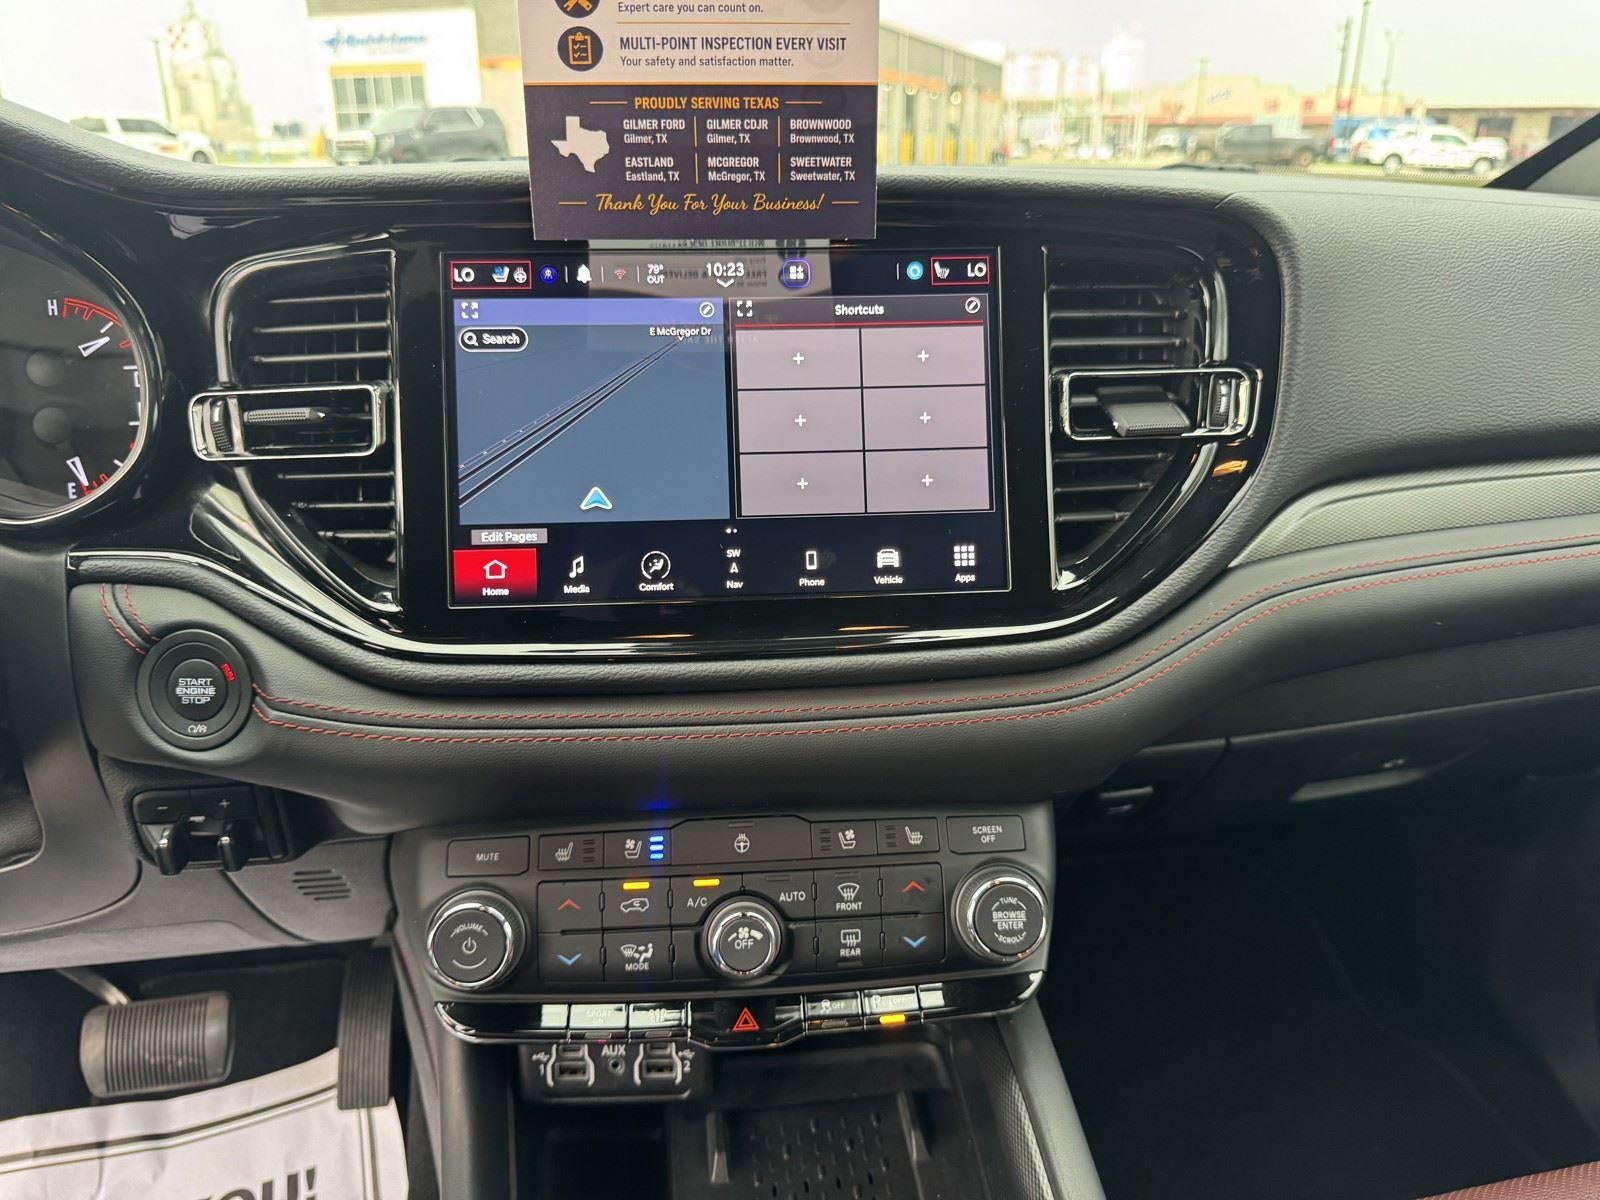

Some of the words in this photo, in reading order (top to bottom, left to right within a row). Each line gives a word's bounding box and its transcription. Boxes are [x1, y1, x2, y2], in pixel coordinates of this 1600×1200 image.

[618, 2, 649, 14] Expert
[653, 4, 674, 13] care
[677, 4, 695, 15] you
[698, 4, 715, 13] can
[718, 3, 746, 13] count
[749, 4, 764, 13] on.
[620, 37, 697, 50] MULTI-POINT
[701, 37, 772, 51] INSPECTION
[776, 37, 814, 51] EVERY
[817, 37, 847, 51] VISIT
[620, 56, 642, 67] Your
[645, 56, 675, 69] safety
[678, 56, 697, 67] and
[699, 56, 757, 67] satisfaction
[759, 57, 794, 67] matter.
[634, 97, 688, 110] PROUDLY
[691, 97, 740, 110] SERVING
[743, 97, 780, 110] TEXAS
[623, 119, 658, 130] GILMER
[660, 119, 686, 130] FORD
[706, 119, 742, 130] GILMER
[743, 119, 769, 130] CDJR
[790, 119, 852, 130] BROWNWOOD
[623, 133, 655, 145] Gilmer,
[656, 134, 668, 144] TX
[706, 133, 737, 145] Gilmer,
[739, 134, 751, 144] TX
[790, 133, 841, 145] Brownwood,
[843, 134, 855, 144] TX
[625, 157, 674, 168] EASTLAND
[707, 157, 760, 168] MCGREGOR
[790, 157, 852, 168] SWEETWATER
[625, 171, 666, 182] Eastland,
[668, 171, 680, 182] TX
[708, 171, 752, 184] McGregor,
[753, 171, 766, 182] TX
[790, 171, 842, 183] Sweetwater,
[844, 171, 856, 182] TX
[595, 193, 645, 211] Thank
[647, 193, 679, 216] You
[683, 194, 708, 211] For
[711, 193, 748, 216] Your
[753, 193, 825, 211] Business!
[706, 261, 744, 277] 10:23
[967, 262, 987, 278] LO
[453, 267, 475, 283] LO
[647, 275, 665, 284] OUT
[47, 299, 58, 315] H
[834, 303, 884, 317] Shortcuts
[656, 327, 699, 338] McGregor
[700, 327, 712, 336] Dr
[482, 332, 521, 346] Search
[67, 482, 78, 499] E
[480, 531, 503, 543] Edit
[504, 531, 538, 544] Pages
[726, 549, 741, 558] SW
[799, 577, 825, 587] Phone
[873, 574, 903, 585] Vehicle
[954, 572, 976, 584] Apps
[563, 584, 590, 594] Media
[638, 582, 674, 592] Comfort
[726, 580, 744, 589] Nav
[482, 586, 509, 596] Home
[178, 678, 213, 686] START
[175, 687, 216, 695] ENGINE
[181, 696, 210, 704] STOP
[972, 824, 1003, 835] SCREEN
[980, 834, 997, 844] OFF
[475, 852, 500, 862] MUTE
[779, 891, 806, 902] AUTO
[686, 897, 709, 908] A/C
[835, 902, 863, 912] FRONT
[992, 910, 1027, 920] BROWSE
[455, 922, 484, 934] VOLUME
[997, 920, 1025, 931] ENTER
[734, 939, 755, 950] OFF
[839, 948, 862, 957] REAR
[625, 962, 650, 972] MODE
[601, 1044, 626, 1056] AUX
[539, 1064, 545, 1076] 1
[683, 1060, 691, 1072] 2
